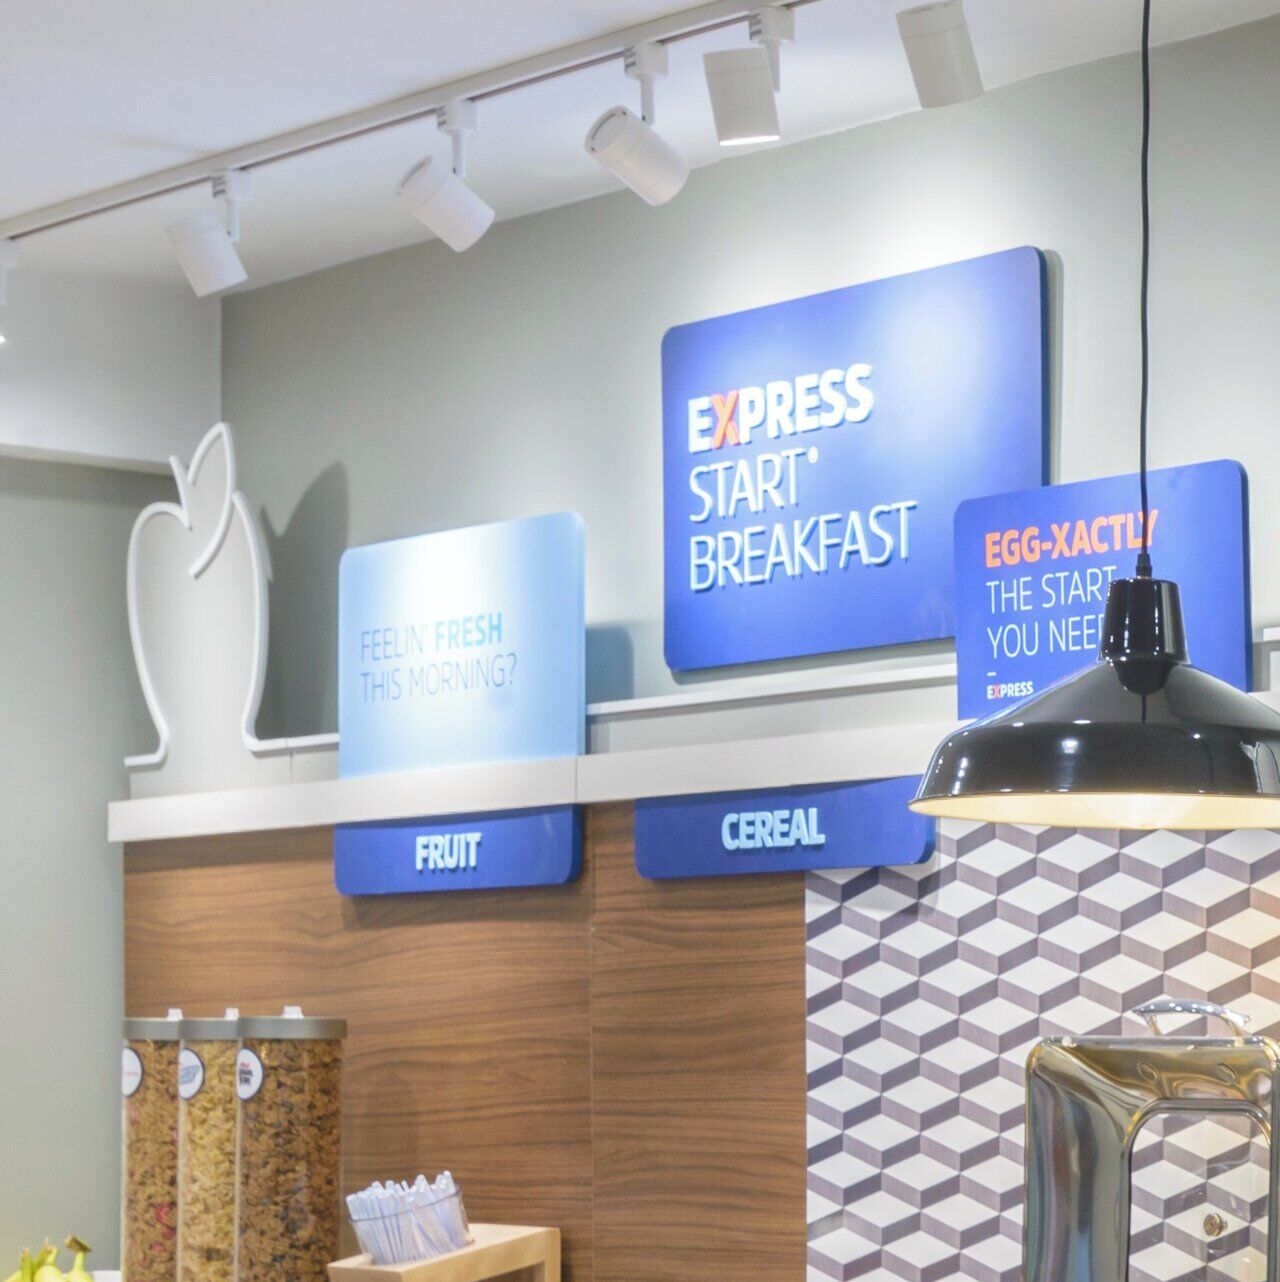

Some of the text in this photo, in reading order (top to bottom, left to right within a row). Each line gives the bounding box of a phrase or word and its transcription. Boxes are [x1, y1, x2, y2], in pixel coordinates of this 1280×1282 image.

[688, 363, 874, 453] EXPRESS
[690, 500, 918, 591] BREAKFAST
[985, 509, 1158, 568] EGG-XACTLY
[986, 566, 1117, 614] THE START
[361, 612, 502, 662] FEELIN' FRESH
[987, 621, 1039, 659] YOU
[361, 652, 517, 703] THIS MORNING?
[987, 681, 1033, 699] EXPRESS
[415, 831, 481, 871] FRUIT
[721, 808, 826, 851] CEREAL
